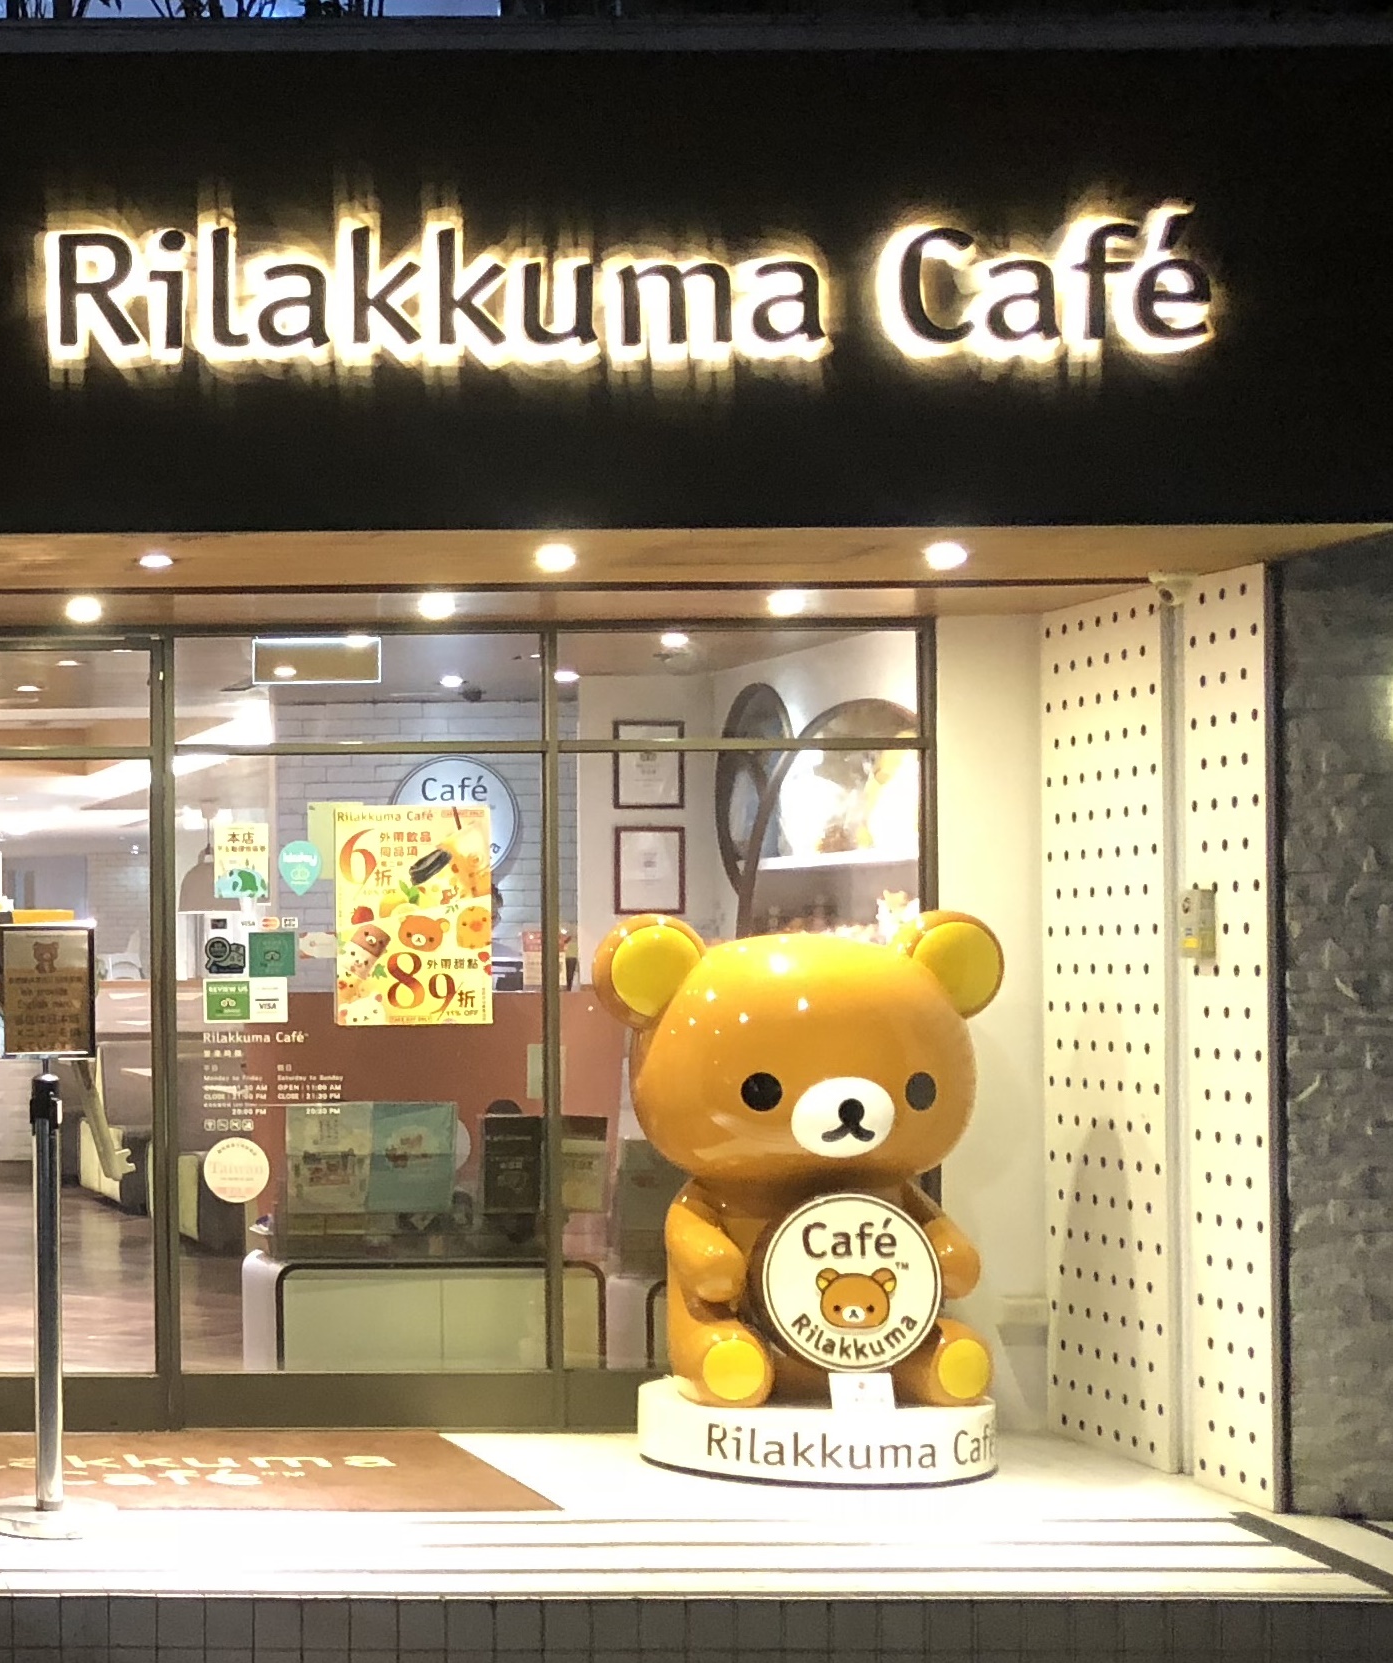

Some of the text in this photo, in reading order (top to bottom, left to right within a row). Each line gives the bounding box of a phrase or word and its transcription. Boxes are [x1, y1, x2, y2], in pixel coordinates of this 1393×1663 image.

[56, 209, 1210, 351] Rilakkuma Café
[421, 775, 489, 802] Café
[337, 811, 402, 822] Rilakkuma
[406, 809, 434, 822] Café
[227, 831, 255, 844] 本店
[463, 1009, 479, 1017] OFF
[202, 1030, 305, 1044] Rilakkuma Café
[277, 1074, 307, 1082] Saturday
[318, 1074, 344, 1082] Sunday
[277, 1092, 300, 1100] CLOSE
[329, 1092, 341, 1100] PM
[329, 1107, 341, 1115] PM
[802, 1217, 898, 1259] Café
[791, 1312, 919, 1361] Rilakkuma
[706, 1422, 938, 1470] Rilakkuma
